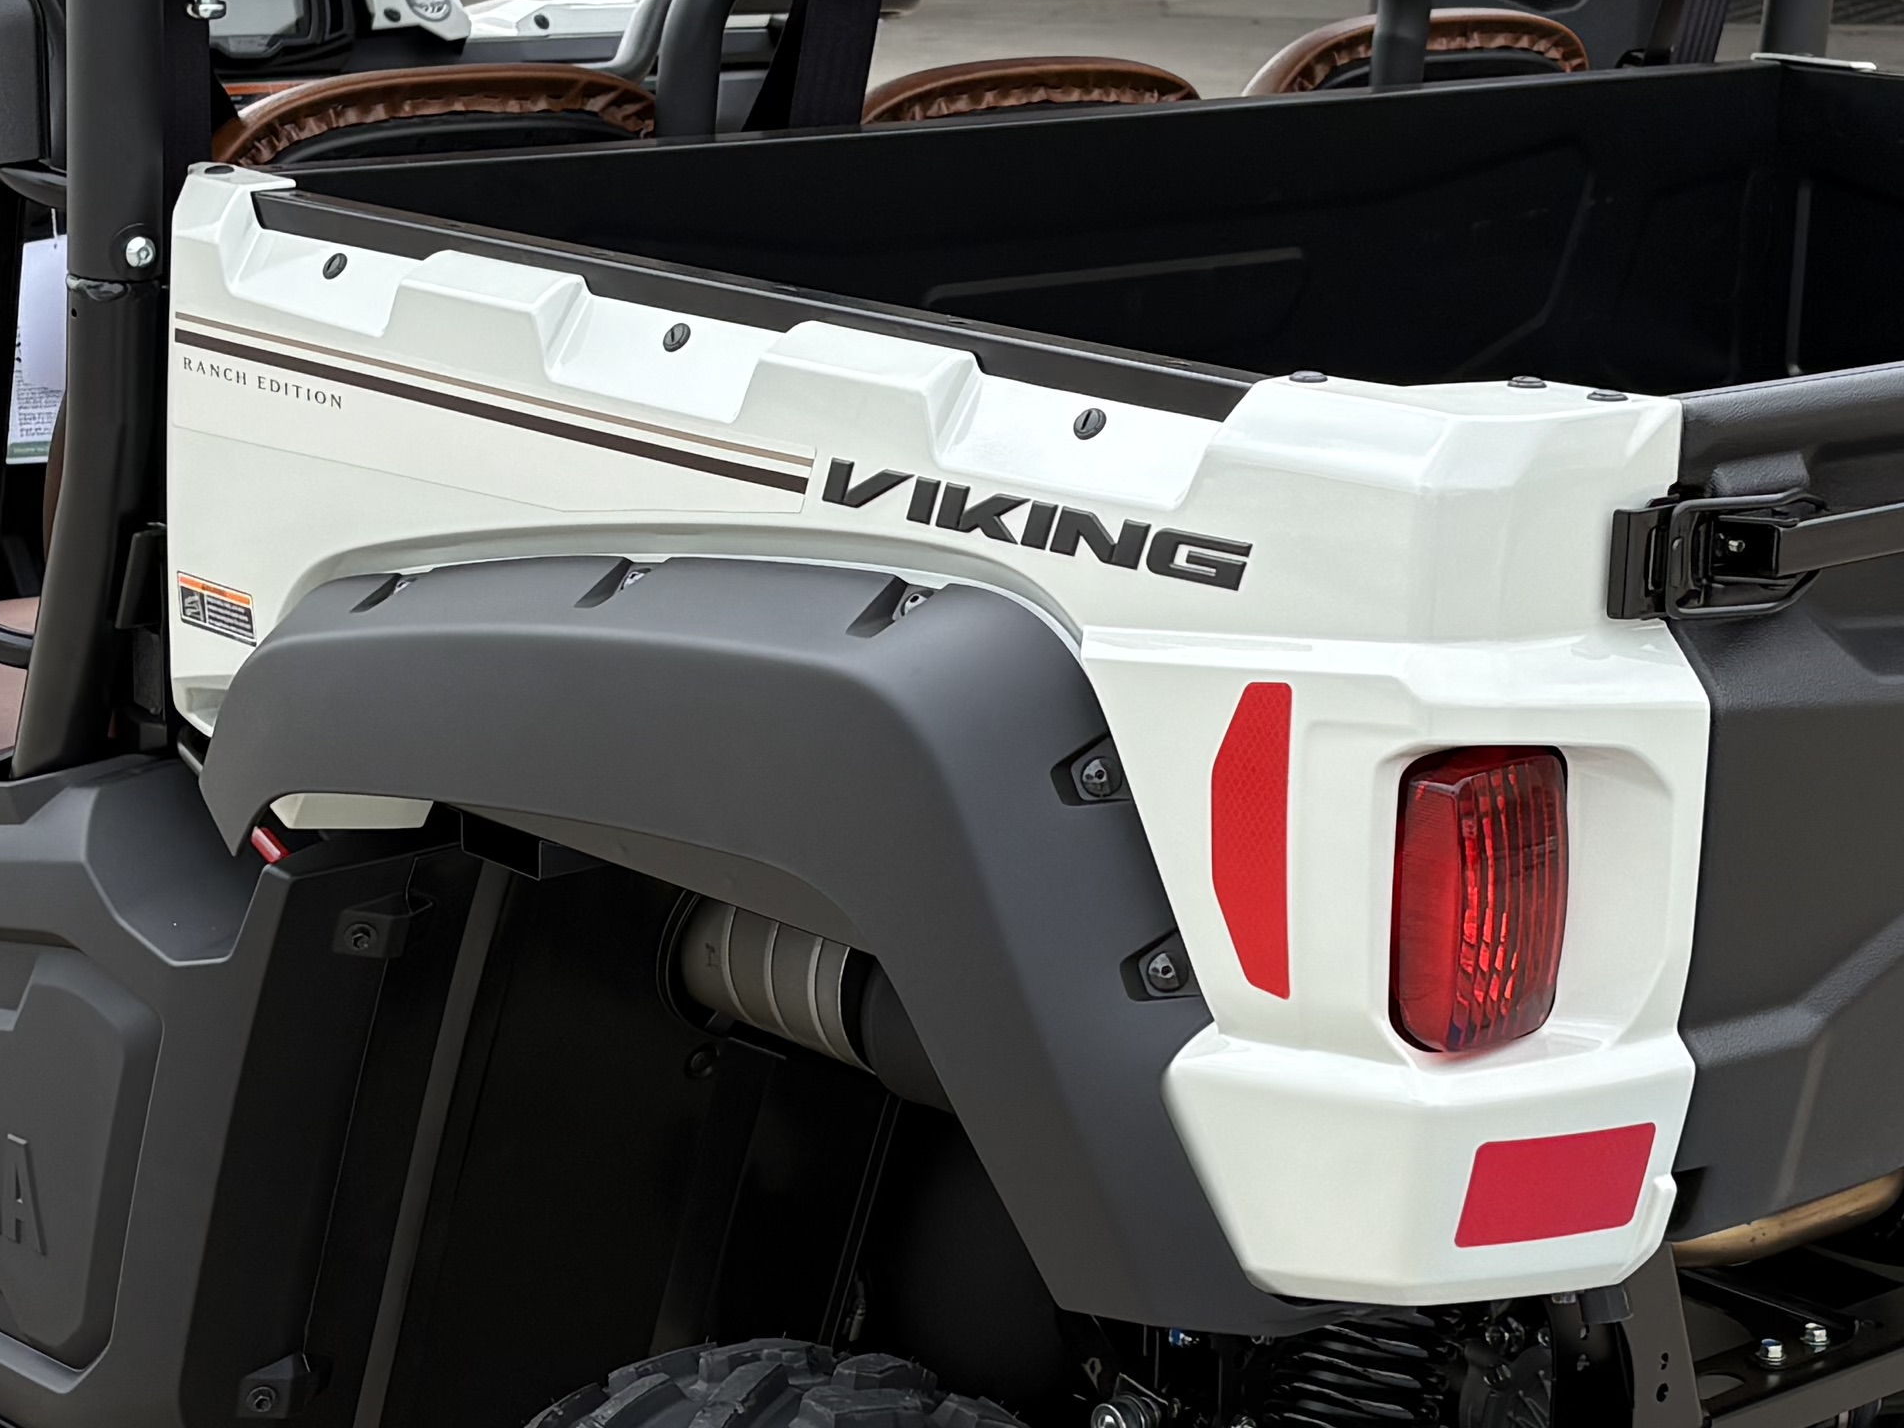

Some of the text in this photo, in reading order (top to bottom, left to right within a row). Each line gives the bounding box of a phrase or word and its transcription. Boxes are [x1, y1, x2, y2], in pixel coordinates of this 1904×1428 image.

[183, 357, 342, 409] RANCH EDITION
[822, 457, 1253, 591] VIKING
